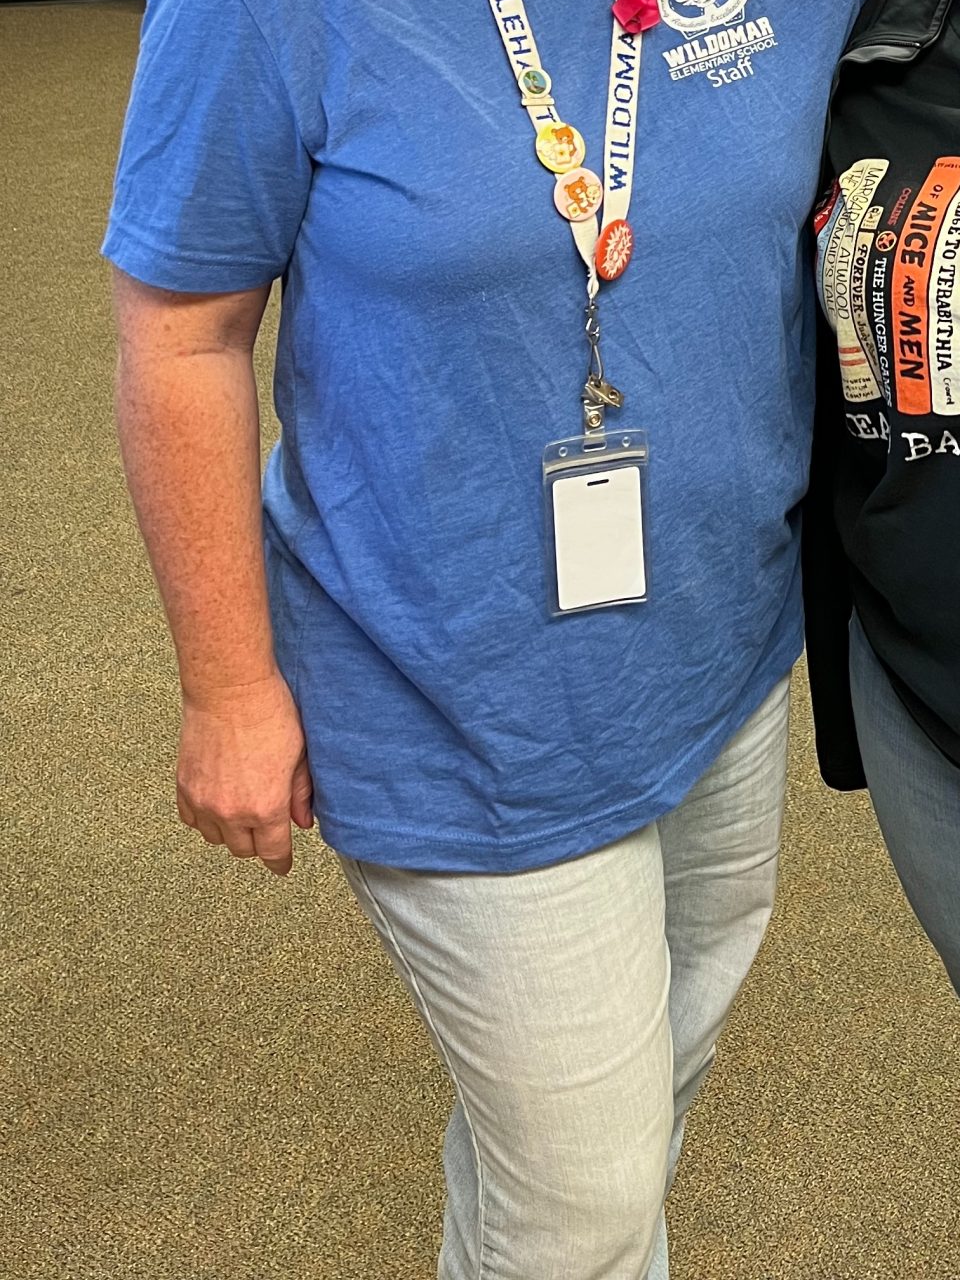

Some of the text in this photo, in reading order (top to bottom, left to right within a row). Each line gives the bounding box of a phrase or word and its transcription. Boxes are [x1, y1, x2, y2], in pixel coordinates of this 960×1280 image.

[662, 16, 774, 68] WILDOMAR
[669, 37, 778, 81] ELEMENTARY SCHOOL
[707, 56, 754, 88] Staff
[609, 32, 636, 192] WILDOMA
[887, 187, 912, 226] COLLINS
[872, 257, 887, 287] THE
[942, 238, 960, 259] TO
[836, 246, 851, 320] ATWOOD
[898, 184, 943, 381] OF MICE AND MEN
[872, 291, 887, 352] HUNGER
[935, 264, 955, 372] TERABITHIA
